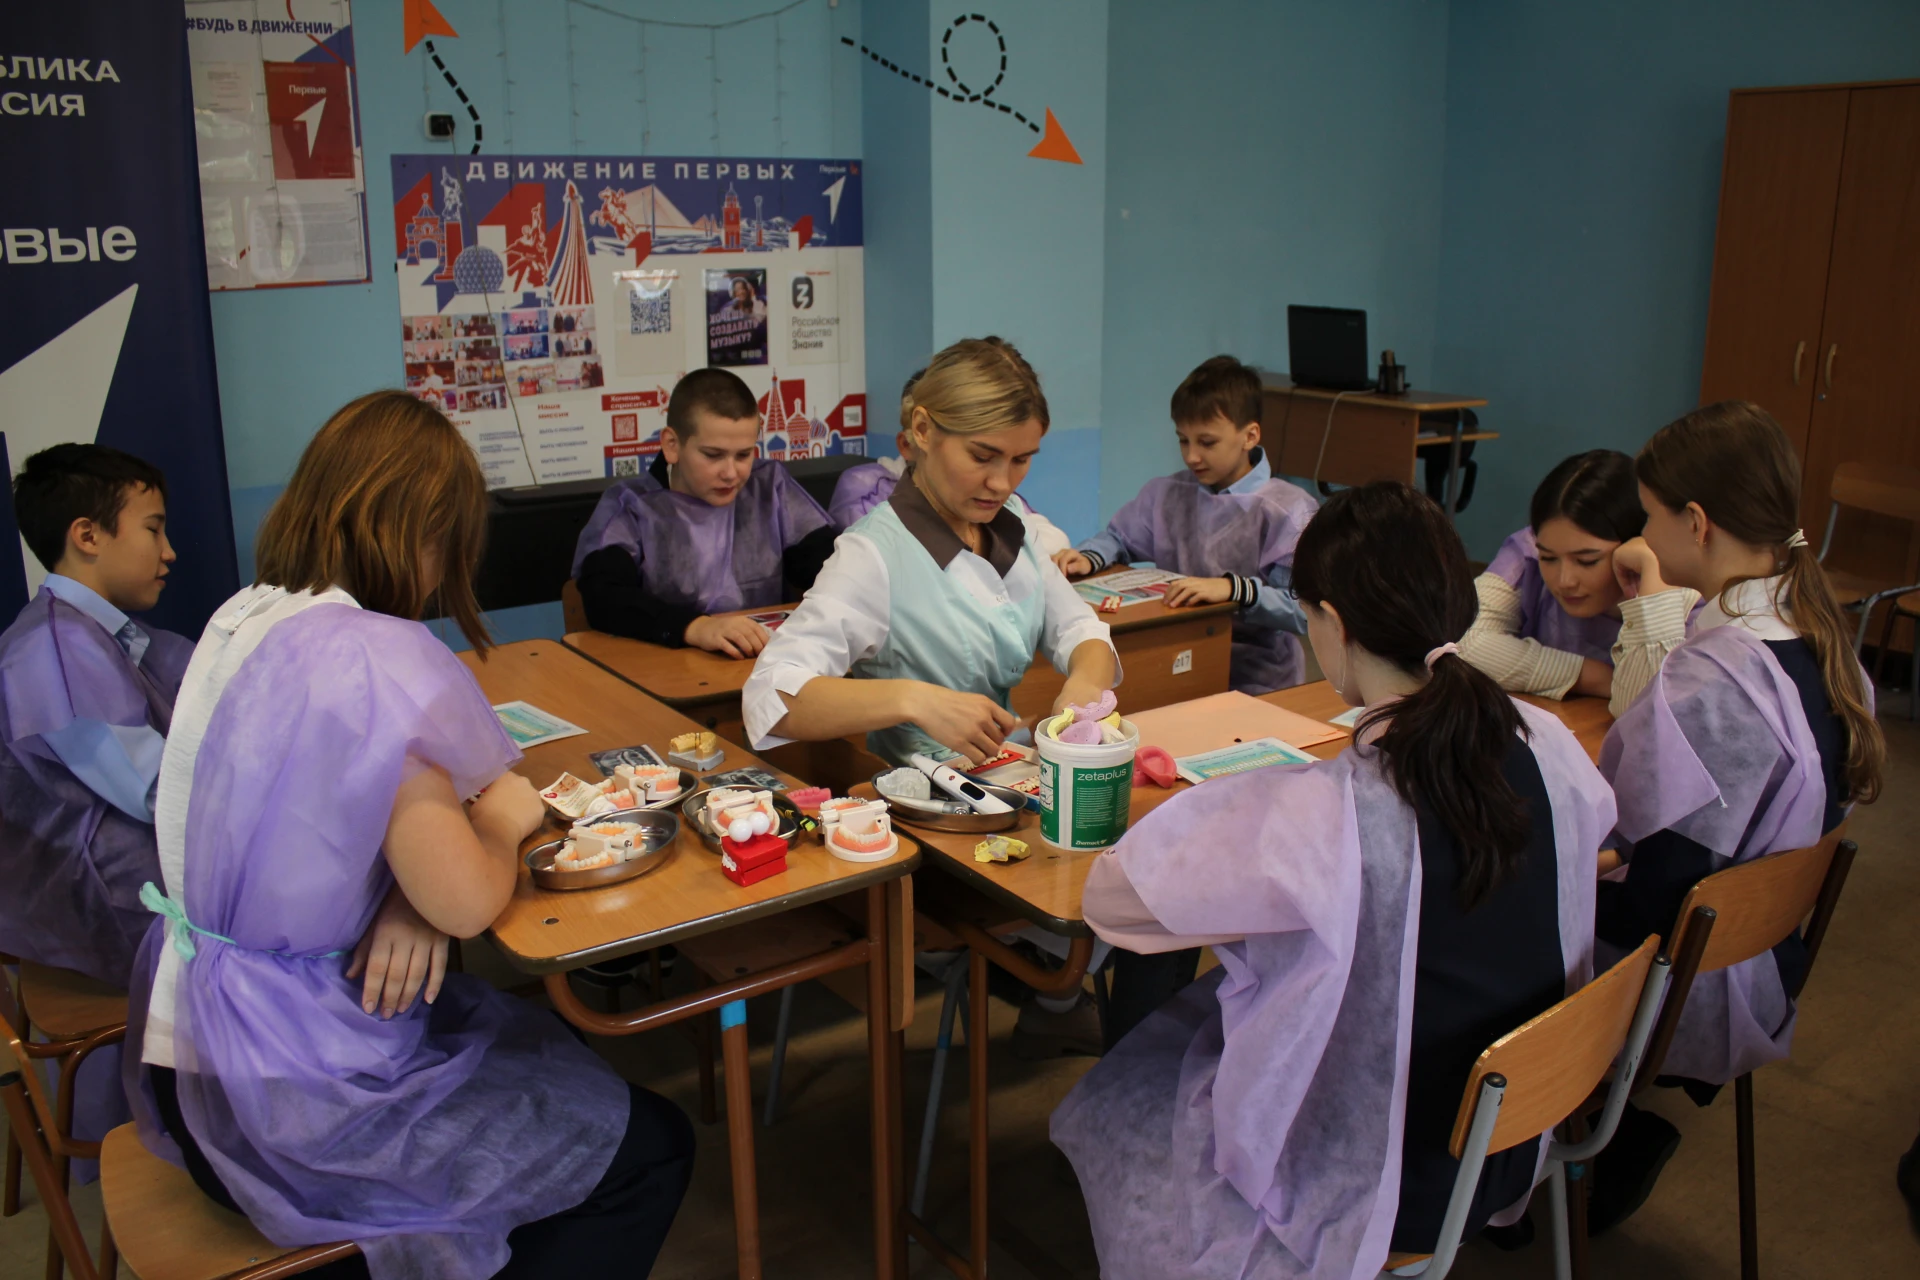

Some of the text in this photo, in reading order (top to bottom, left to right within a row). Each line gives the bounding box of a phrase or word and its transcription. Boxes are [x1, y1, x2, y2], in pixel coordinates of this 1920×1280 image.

[186, 17, 333, 35] #БУДЬ В ДВИЖЕНИИ
[288, 84, 327, 97] Первые
[0, 91, 86, 117] СИЯ
[465, 161, 795, 182] ДВИЖЕНИЕ ПЕРВЫХ
[0, 225, 137, 264] вые
[709, 319, 760, 337] СОЗДАВАТЬ
[791, 315, 840, 327] Российское
[710, 332, 752, 349] МУЗЫКУ?
[791, 339, 824, 350] Знание
[1077, 768, 1127, 782] zetaplus
